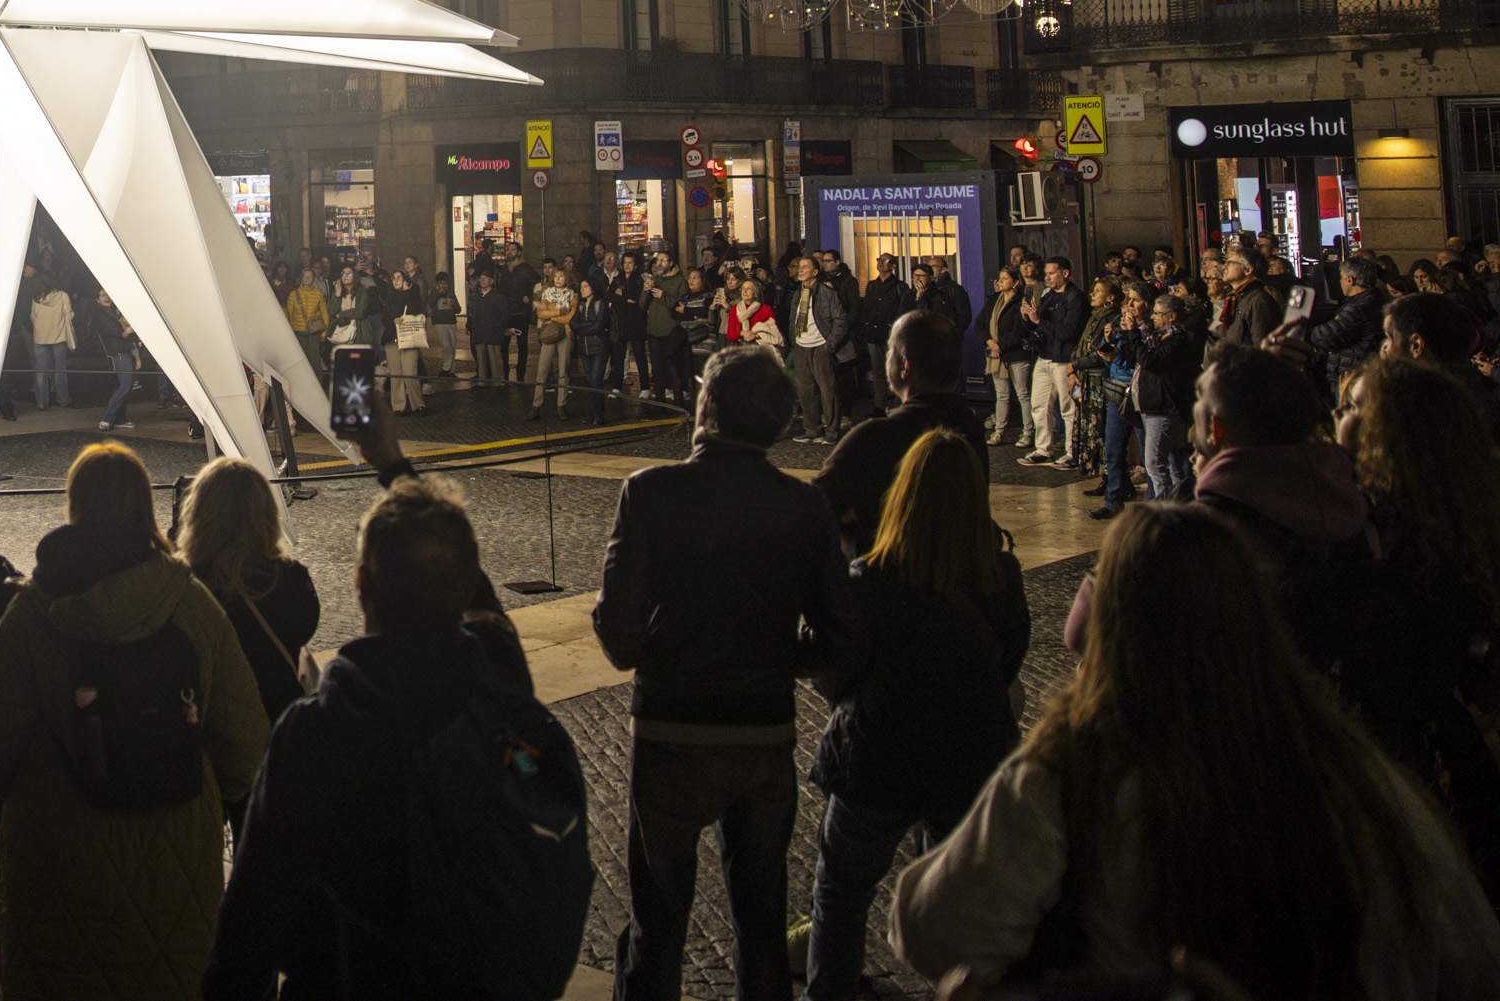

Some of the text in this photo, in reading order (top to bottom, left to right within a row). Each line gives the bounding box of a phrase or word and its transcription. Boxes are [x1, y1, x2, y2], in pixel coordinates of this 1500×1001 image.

[1067, 101, 1101, 110] ATENCIÓ
[1213, 115, 1348, 144] sunglass hut
[458, 155, 511, 172] Alcampo
[1081, 165, 1094, 174] 10
[824, 184, 975, 201] NADAL A SANT JAUME
